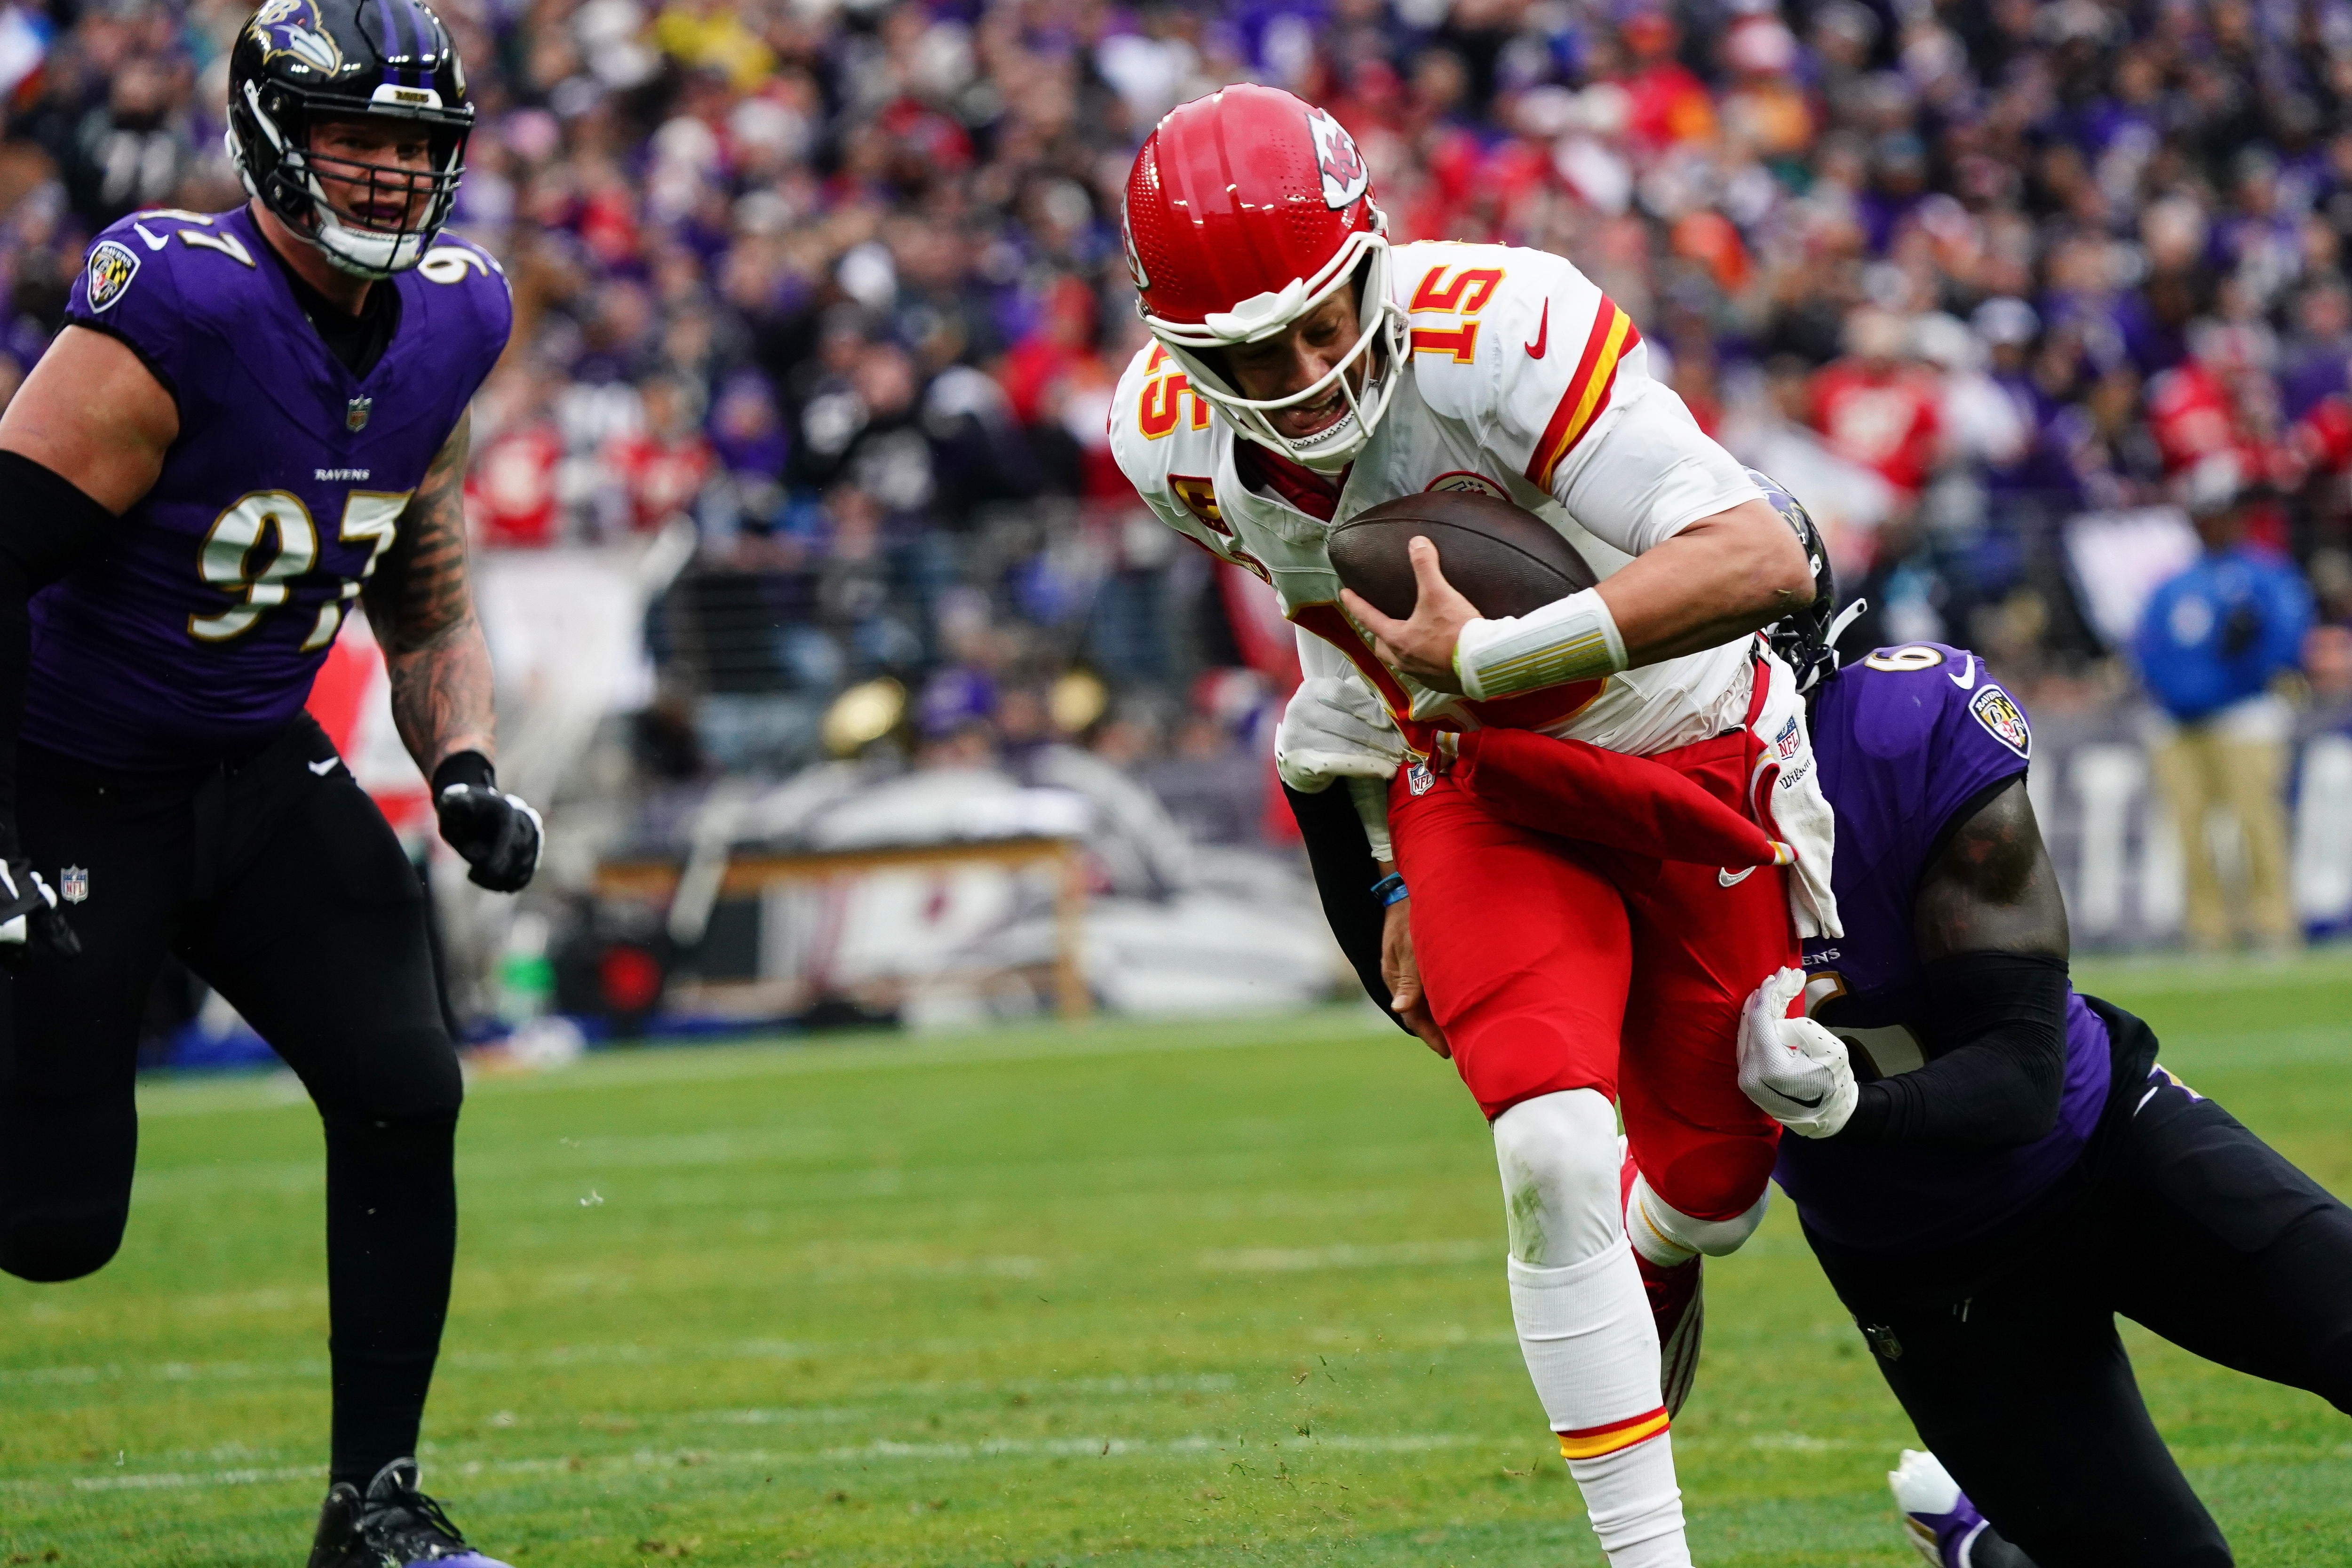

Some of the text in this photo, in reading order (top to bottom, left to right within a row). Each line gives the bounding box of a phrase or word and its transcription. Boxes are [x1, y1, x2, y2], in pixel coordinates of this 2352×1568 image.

[101, 246, 132, 269] RAVENS
[1408, 263, 1507, 365] 15
[314, 469, 371, 482] RAVENS
[187, 487, 416, 653] 97
[1975, 690, 2002, 711] RAVENS
[1778, 732, 1799, 757] NFL
[1413, 775, 1431, 790] NFL
[67, 881, 83, 895] NFL
[1802, 948, 1841, 966] ENS
